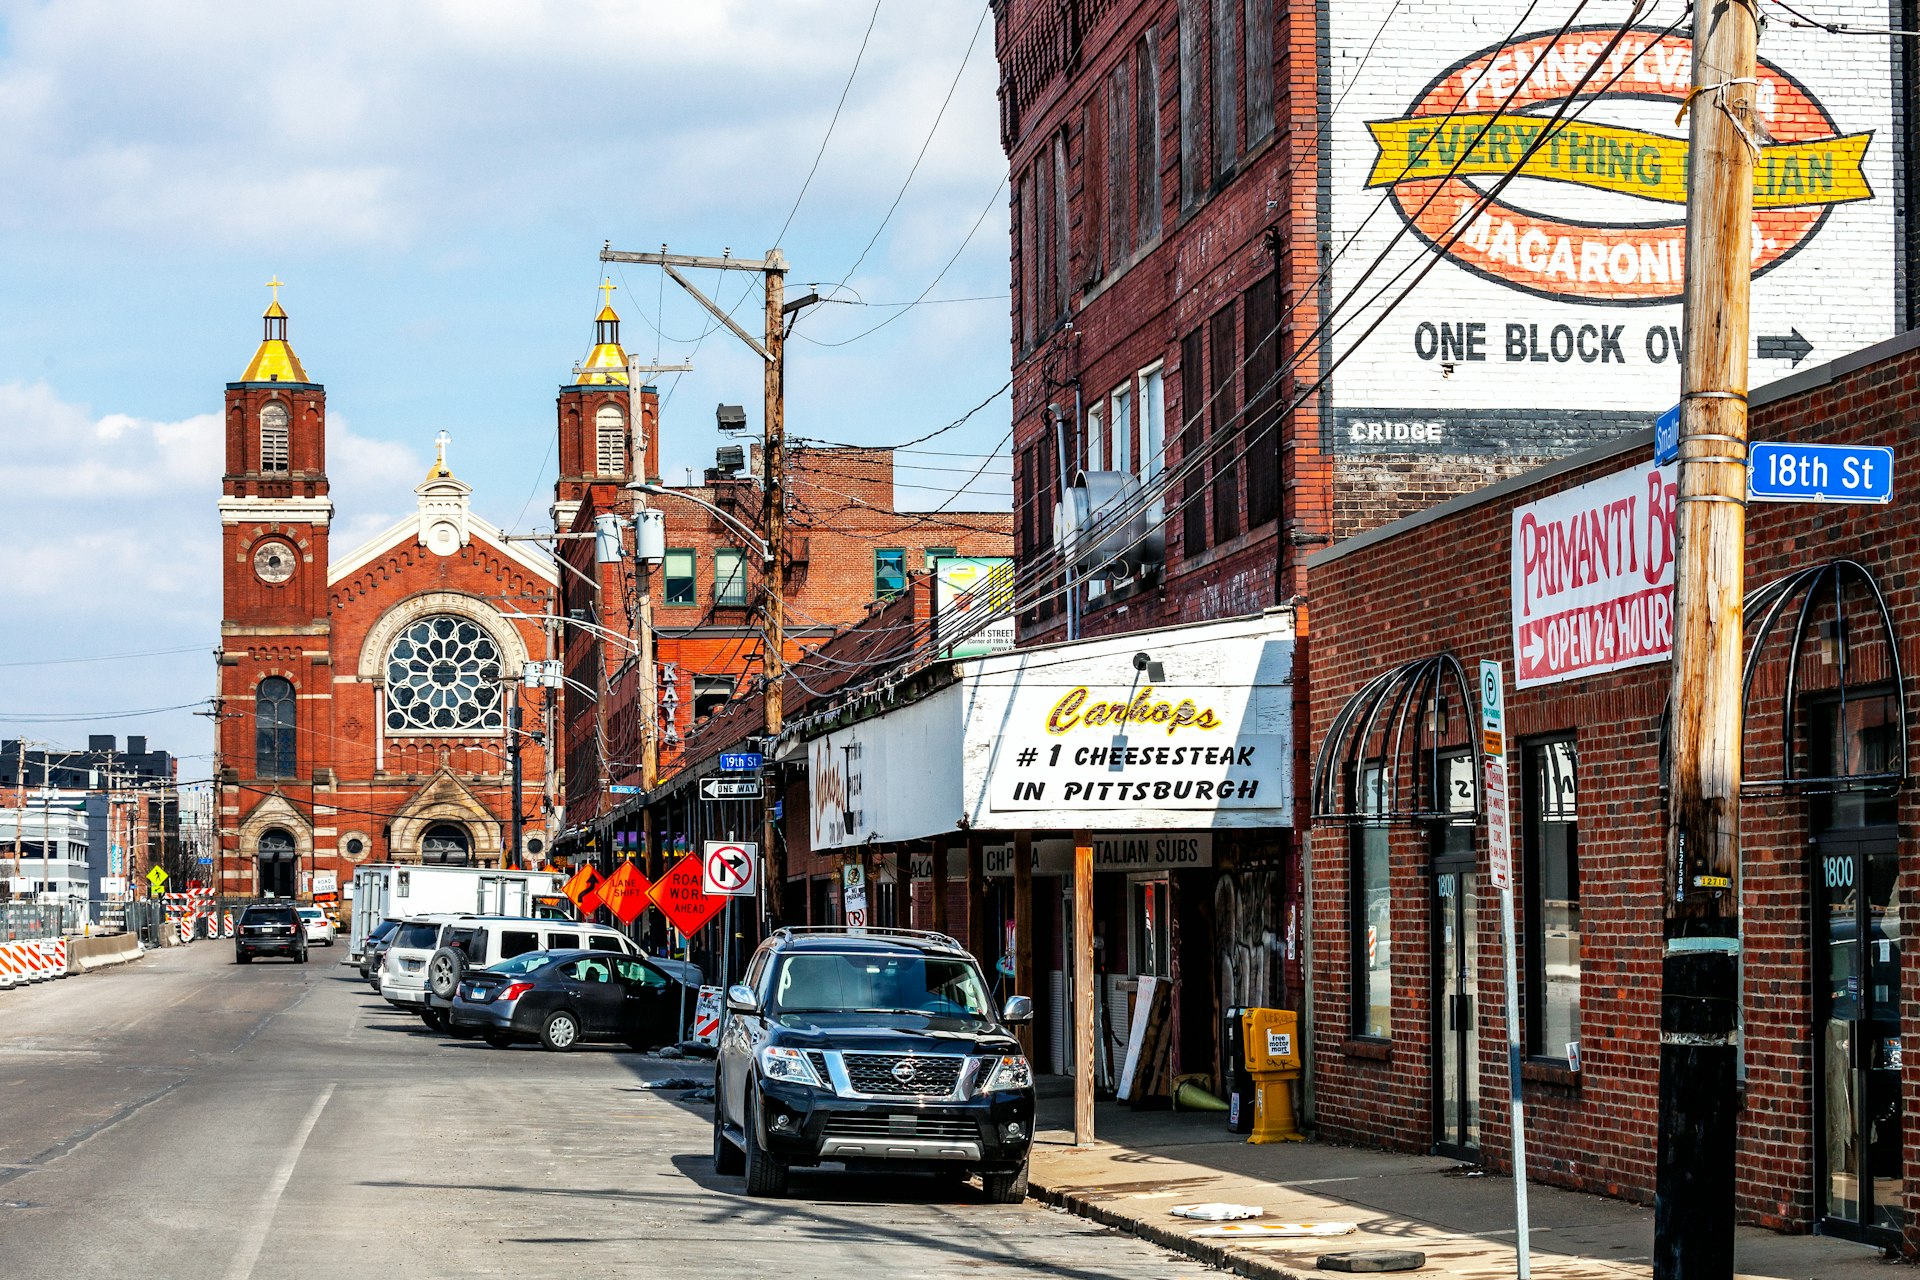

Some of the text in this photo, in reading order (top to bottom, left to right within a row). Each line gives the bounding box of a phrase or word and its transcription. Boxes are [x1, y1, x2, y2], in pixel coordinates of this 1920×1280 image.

[1406, 124, 1662, 186] EVERYTHING
[1450, 200, 1682, 284] MACARONI
[1414, 321, 1487, 361] ONE
[1505, 323, 1626, 364] BLOCK
[1350, 423, 1442, 442] CRIDGE
[1768, 453, 1874, 489] 18th St
[1519, 470, 1677, 617] PRIMANTI BR
[987, 629, 1014, 638] STREET
[1547, 612, 1593, 671] OPEN
[1593, 607, 1614, 661] 24
[662, 661, 680, 743] KAYA
[1046, 684, 1223, 736] Carhops
[725, 756, 758, 767] 19th St
[1016, 743, 1256, 767] # 1 CHEESESTEAK
[717, 784, 756, 793] ONE WAY
[1012, 780, 1259, 801] IN PITTSBURGH
[1094, 839, 1198, 864] TALIAN SUBS
[612, 879, 636, 888] LANE
[1823, 855, 1854, 888] 1800
[614, 889, 640, 897] SHIFT
[1438, 874, 1456, 898] 1800
[674, 904, 705, 914] AHEAD
